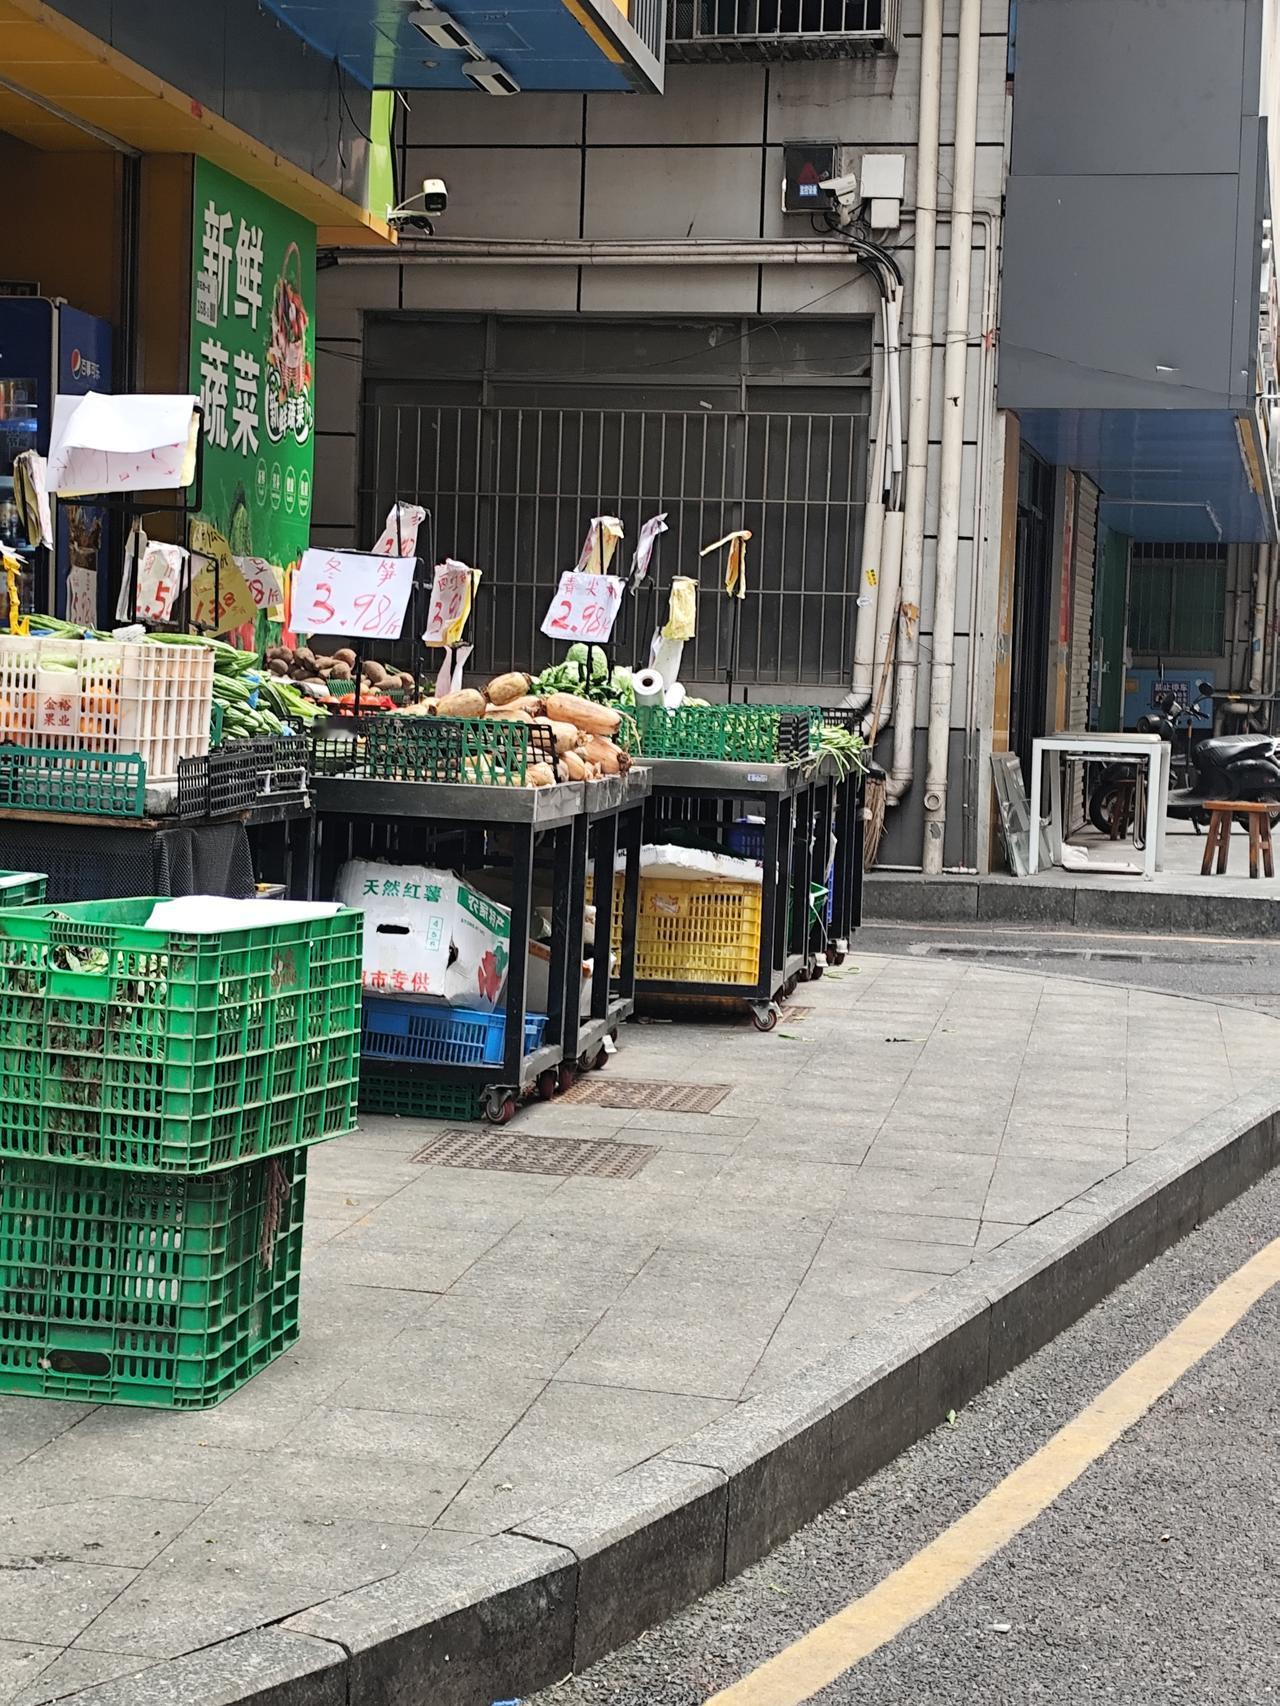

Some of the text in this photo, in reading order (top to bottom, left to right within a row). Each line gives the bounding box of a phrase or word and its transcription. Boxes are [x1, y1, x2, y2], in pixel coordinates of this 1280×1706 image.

[203, 200, 263, 330] 新鲜
[199, 337, 260, 456] 蔬菜
[268, 391, 306, 436] 新鲜蔬菜
[326, 556, 397, 587] 冬笋
[44, 696, 72, 712] 金裕
[43, 713, 71, 727] 果业
[362, 879, 443, 903] 天然红薯
[467, 895, 505, 930] 农家特产
[362, 969, 430, 992] 市专供
